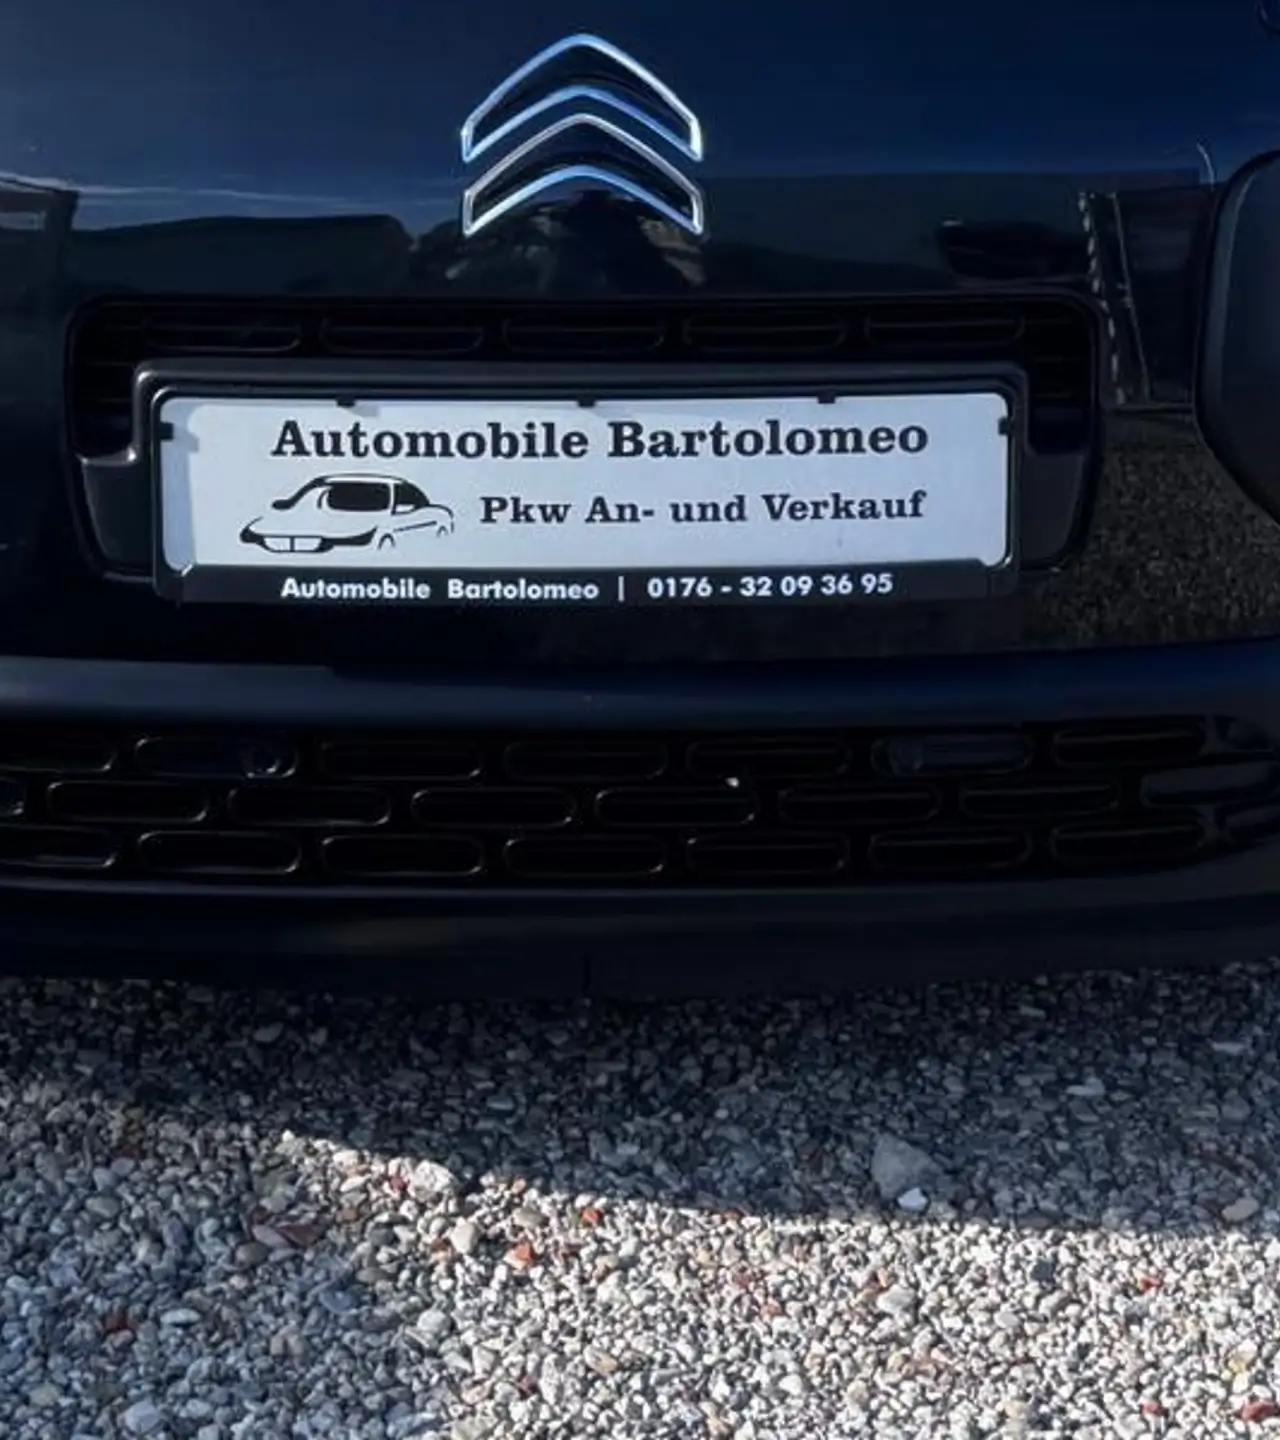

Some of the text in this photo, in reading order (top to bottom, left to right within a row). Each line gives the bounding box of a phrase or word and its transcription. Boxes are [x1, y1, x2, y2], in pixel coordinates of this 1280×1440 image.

[271, 419, 929, 459] Automobile Bartolomeo
[480, 489, 927, 524] Pkw An- und Verkauf
[280, 577, 431, 599] Automobile
[447, 576, 600, 600] Bartolomeo
[647, 576, 713, 598] 0176
[739, 575, 773, 597] 32
[780, 575, 814, 597] 09
[820, 574, 853, 596] 36
[860, 573, 893, 594] 95
